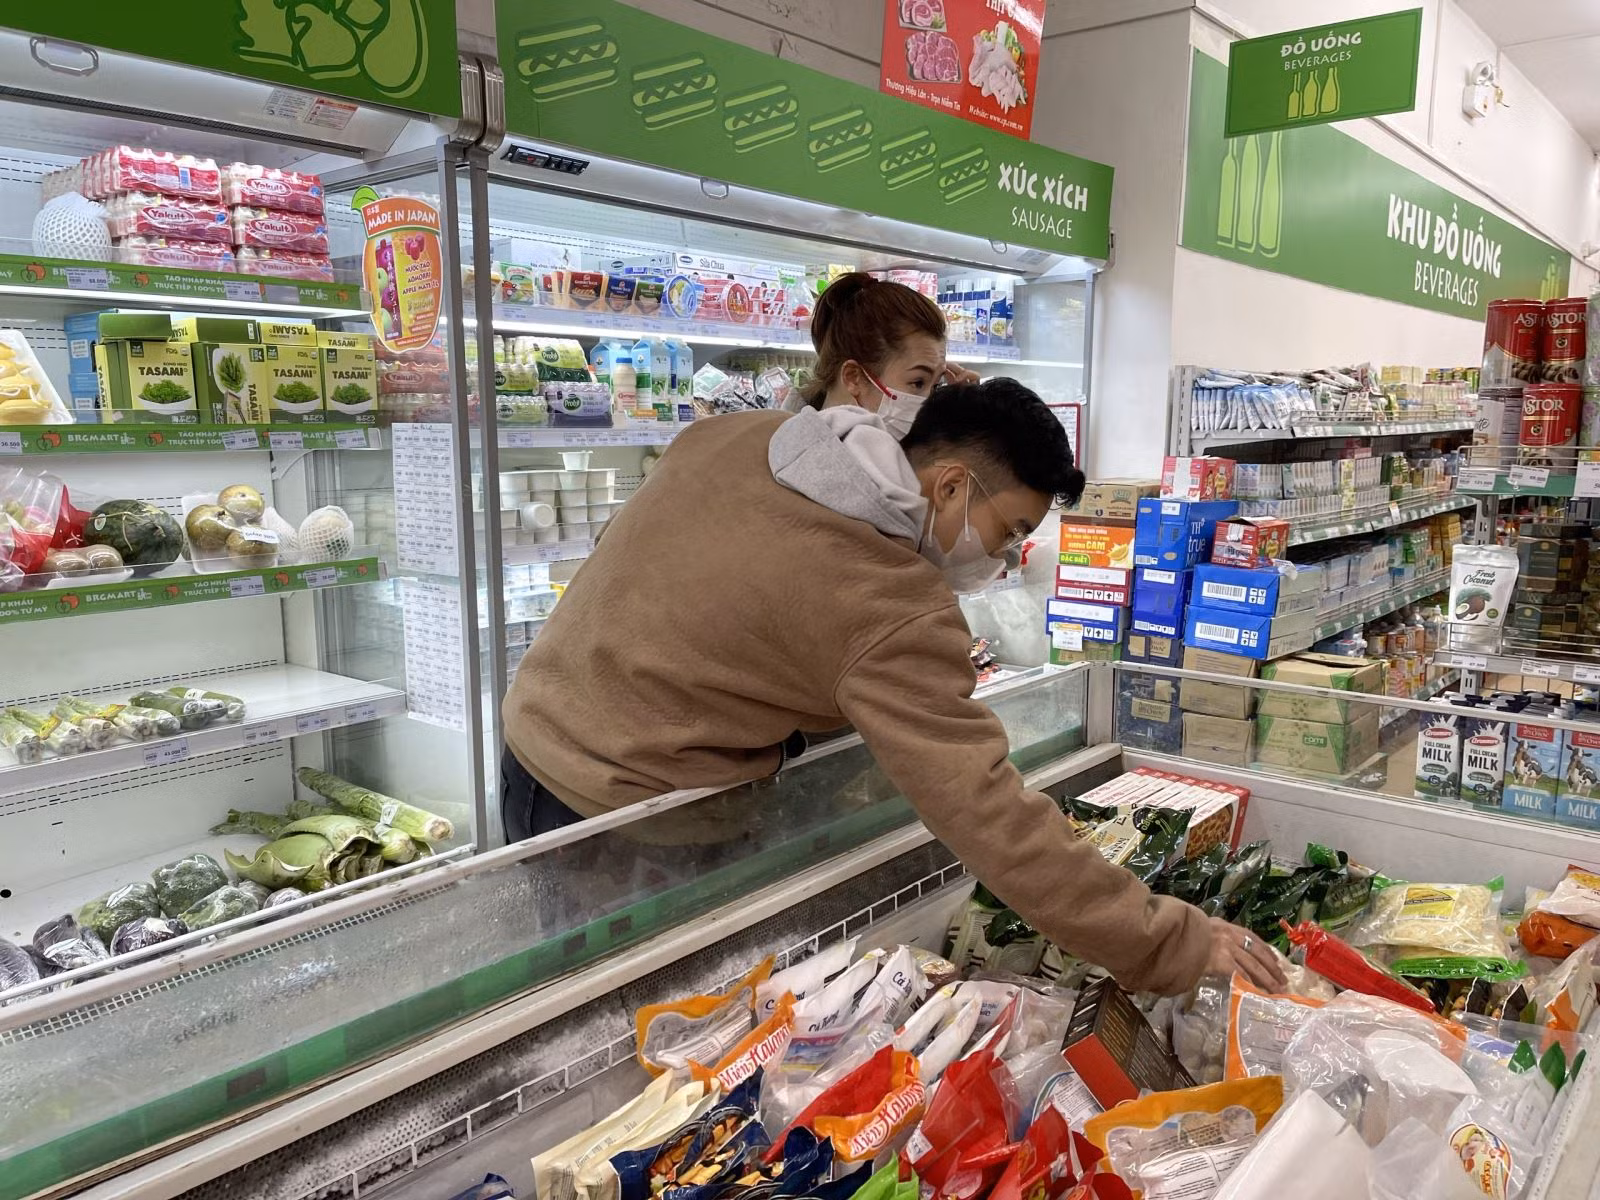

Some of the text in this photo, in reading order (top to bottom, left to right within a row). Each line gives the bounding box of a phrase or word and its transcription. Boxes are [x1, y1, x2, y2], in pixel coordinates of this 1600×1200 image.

[1280, 31, 1362, 57] ĐỒ UỐNG
[1284, 50, 1352, 71] BEVERAGES
[253, 181, 285, 193] Yakult
[998, 161, 1088, 212] XÚC XÍCH
[150, 208, 186, 221] Yakult
[368, 209, 436, 231] MADE IN JAPAN
[258, 221, 290, 233] Yakult
[1012, 206, 1073, 239] SAUSAGE
[1387, 193, 1502, 279] KHU ĐỒ UỐNG
[157, 252, 193, 263] Yakult
[1414, 260, 1480, 308] BEVERAGES
[272, 325, 310, 335] TASAMI
[328, 339, 356, 347] TASAMI
[138, 366, 185, 377] TASAMI
[273, 369, 313, 378] TASAMI
[332, 370, 369, 380] TASAMI
[248, 383, 259, 421] TASAMI
[68, 434, 119, 442] BRGMART
[1188, 537, 1206, 552] true
[1463, 575, 1496, 586] Coconut
[1475, 570, 1496, 578] Fresh
[86, 590, 136, 602] BRGMART
[1422, 747, 1452, 763] MILK
[1468, 754, 1499, 771] MILK
[1514, 793, 1542, 810] MILK
[1568, 802, 1597, 820] MILK
